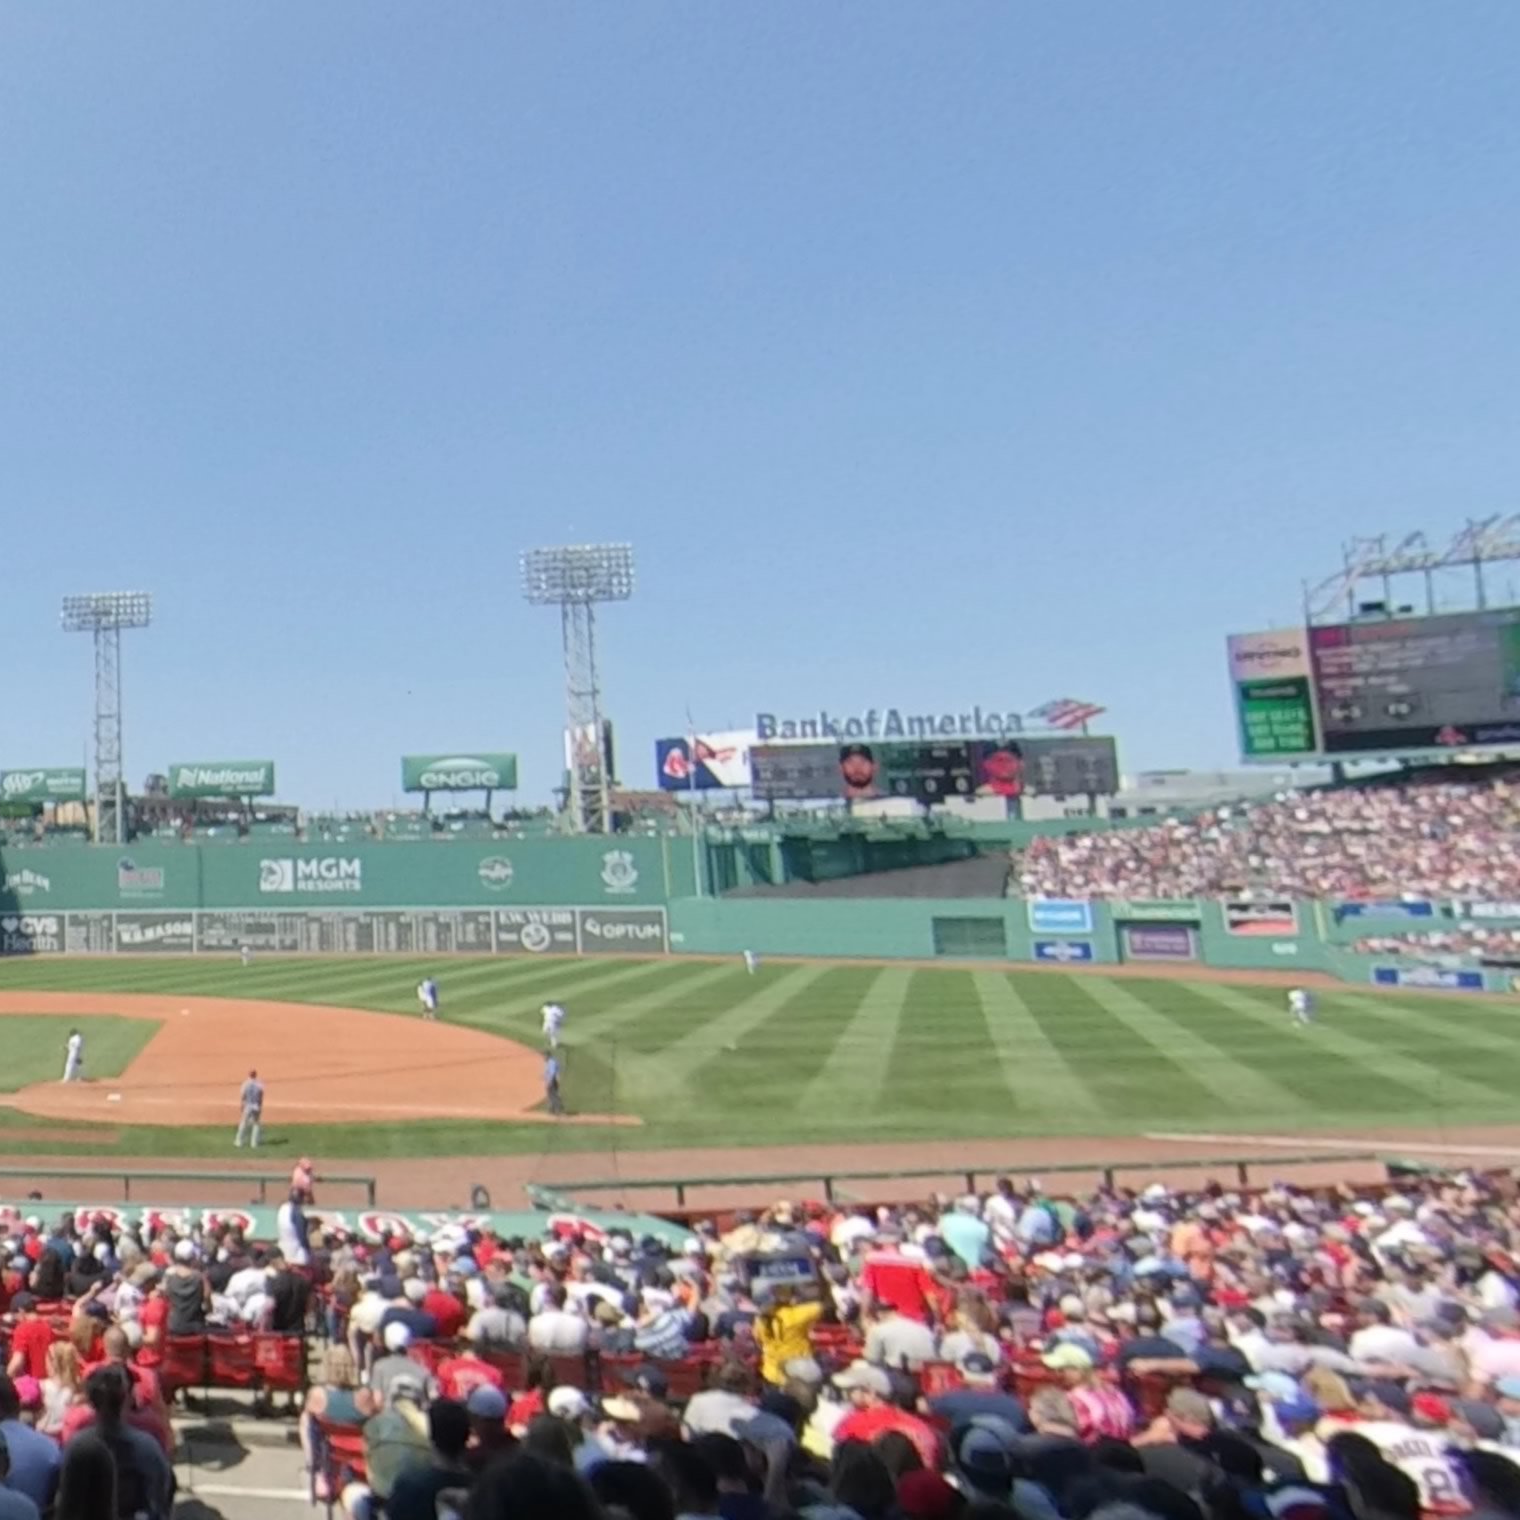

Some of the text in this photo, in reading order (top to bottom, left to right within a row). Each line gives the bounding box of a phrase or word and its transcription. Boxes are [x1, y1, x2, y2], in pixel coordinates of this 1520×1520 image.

[756, 704, 1026, 740] Bank of America
[197, 767, 266, 786] National
[297, 858, 361, 878] MGM
[297, 879, 361, 891] RESORTS
[19, 916, 58, 934] CVS
[602, 923, 661, 939] OPTUM
[3, 934, 58, 950] Health
